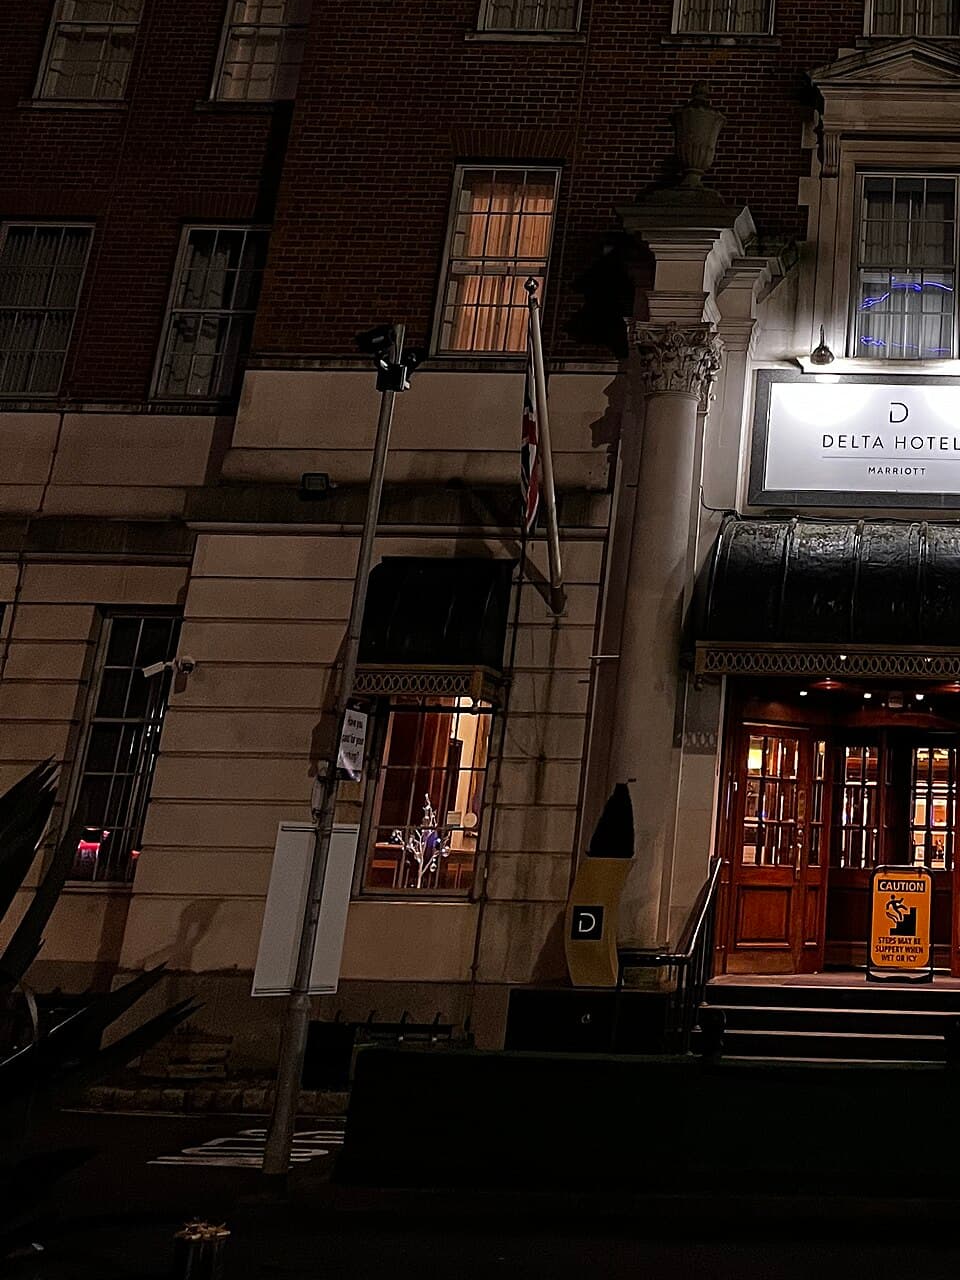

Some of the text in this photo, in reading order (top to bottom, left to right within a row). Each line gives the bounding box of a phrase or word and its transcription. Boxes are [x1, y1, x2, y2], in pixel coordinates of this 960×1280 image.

[889, 401, 909, 423] D
[822, 434, 884, 449] DELTA
[868, 467, 926, 476] MARRIOTT
[879, 881, 924, 892] CAUTION
[578, 913, 596, 933] D
[878, 937, 921, 945] STEPS MAY BE
[875, 945, 924, 954] SLIPPERY WHEN
[895, 954, 905, 962] OR
[906, 954, 918, 962] ICY
